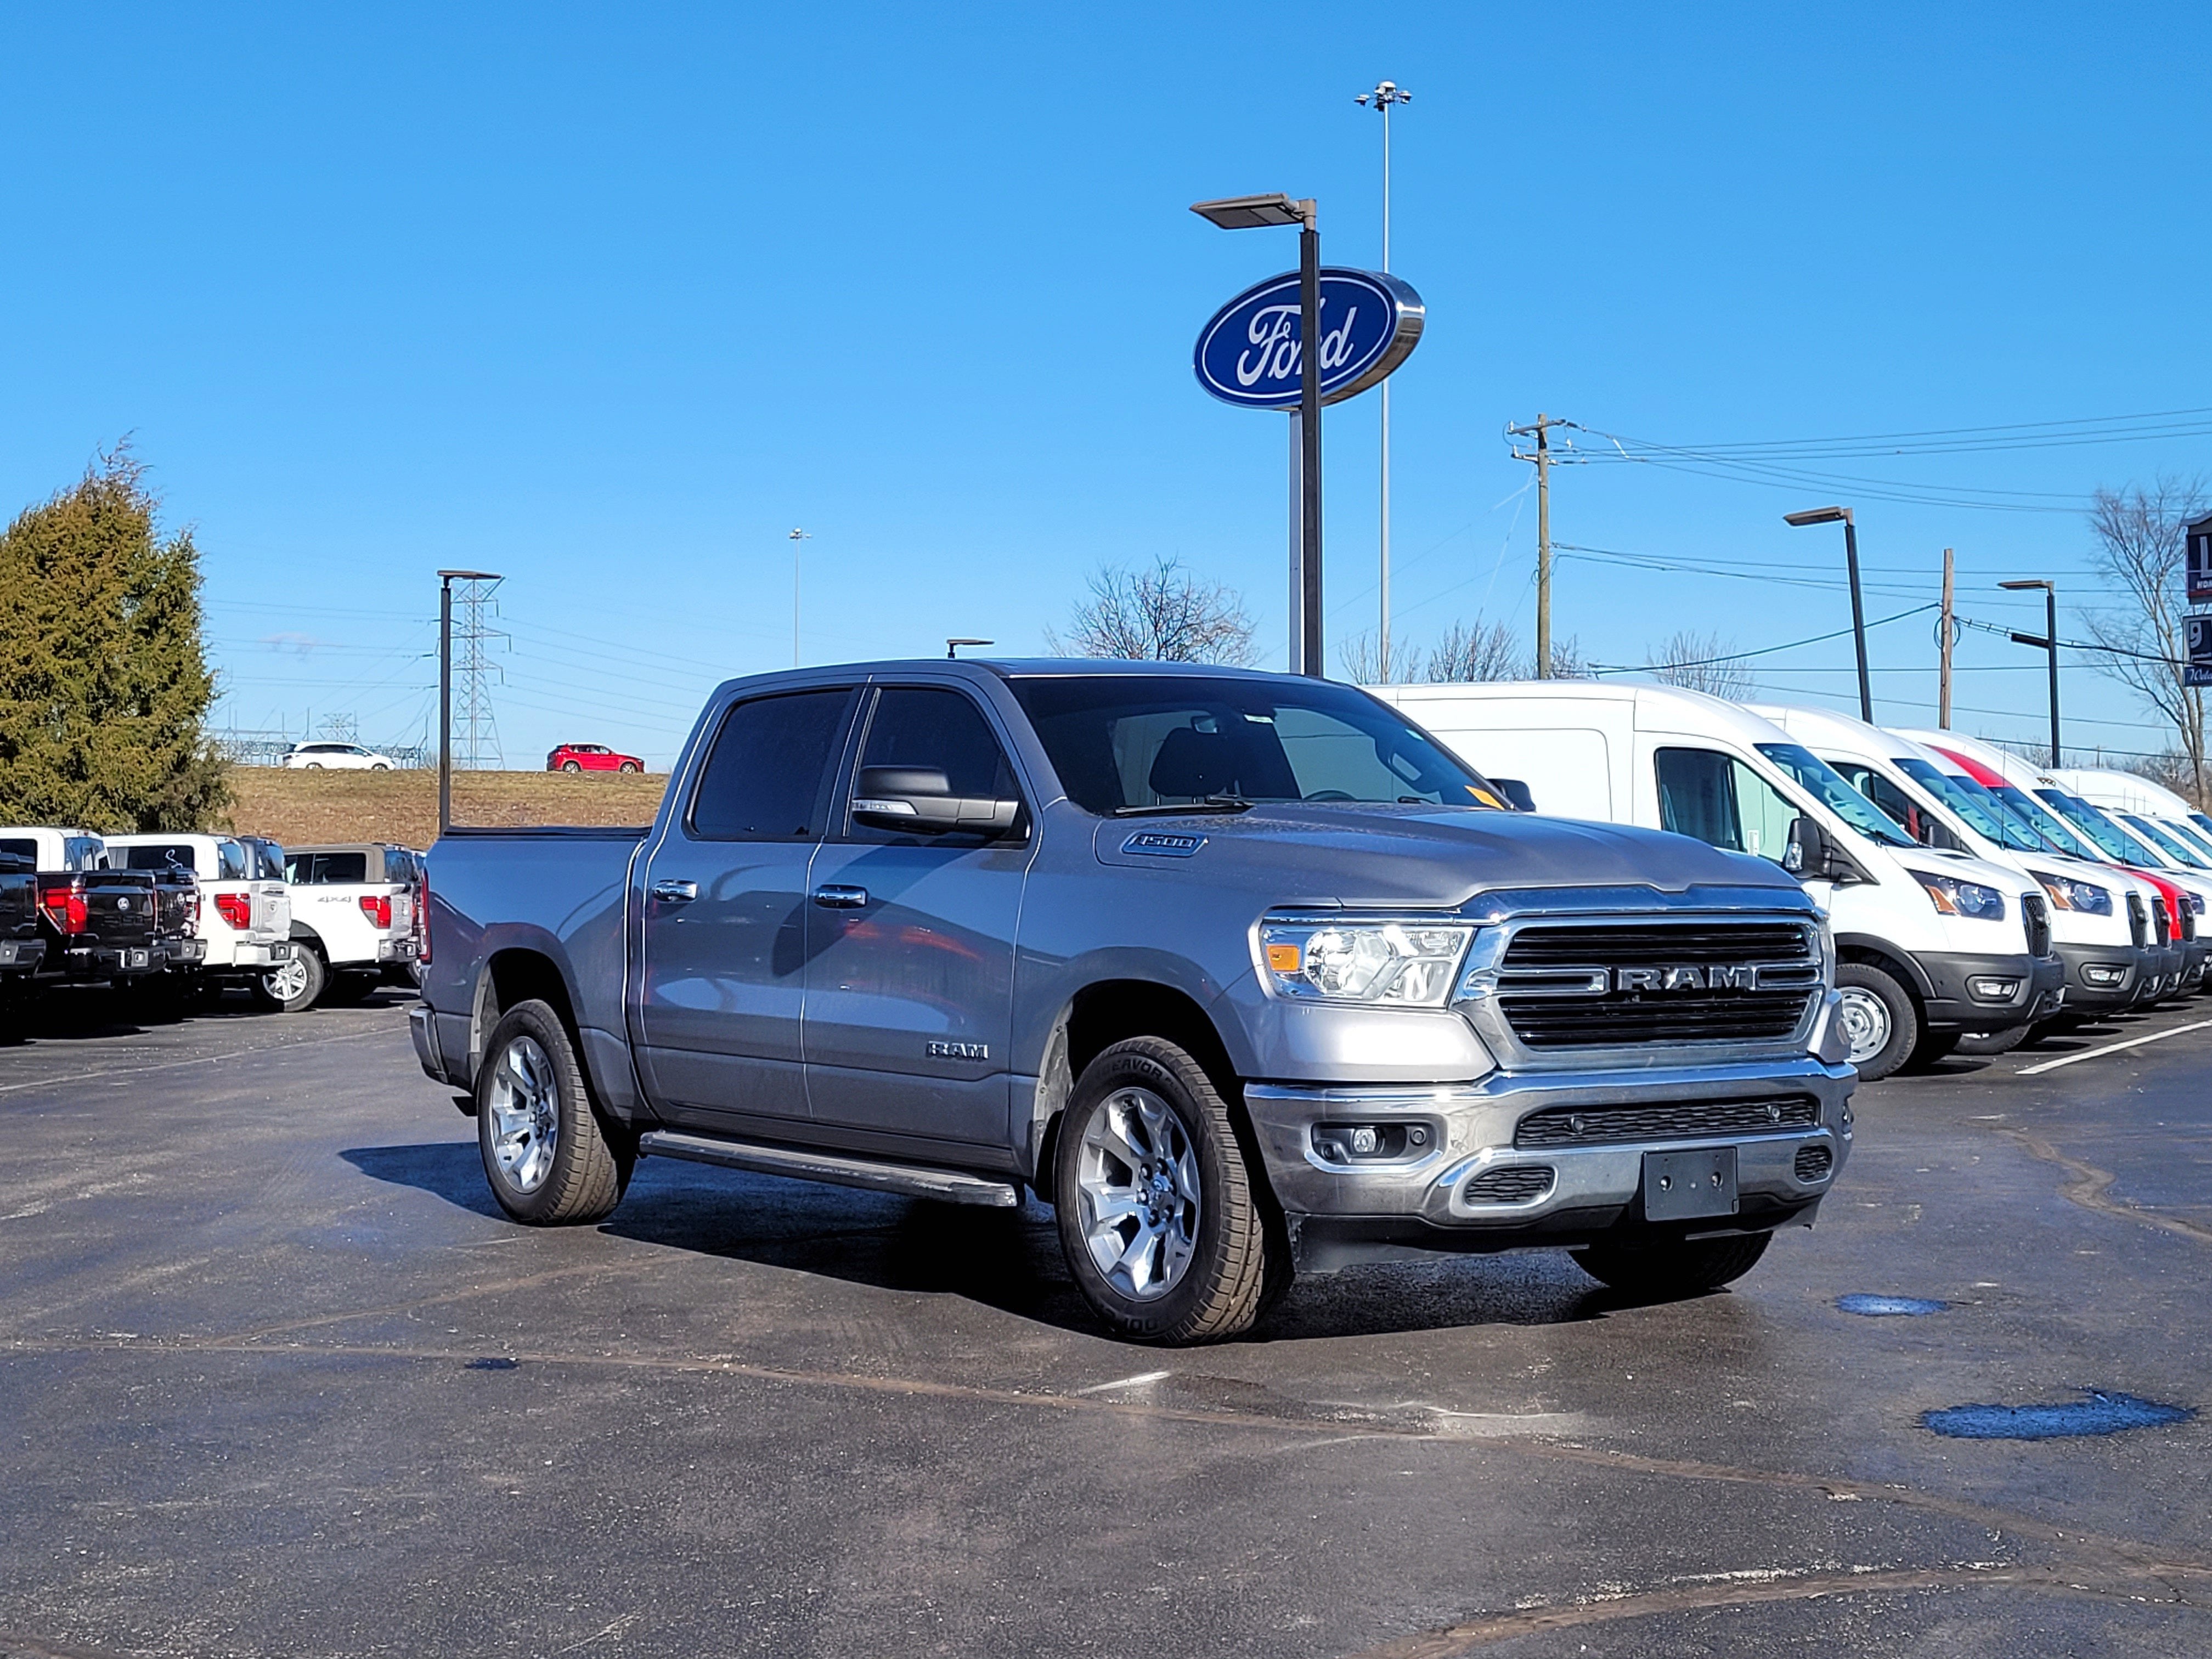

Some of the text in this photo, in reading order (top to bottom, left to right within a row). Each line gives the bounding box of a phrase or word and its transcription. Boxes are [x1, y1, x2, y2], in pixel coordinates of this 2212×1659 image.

[1236, 298, 1357, 386] Fod
[1139, 835, 1194, 847] 1500
[1617, 967, 1751, 991] RAM
[928, 1040, 988, 1059] RAM
